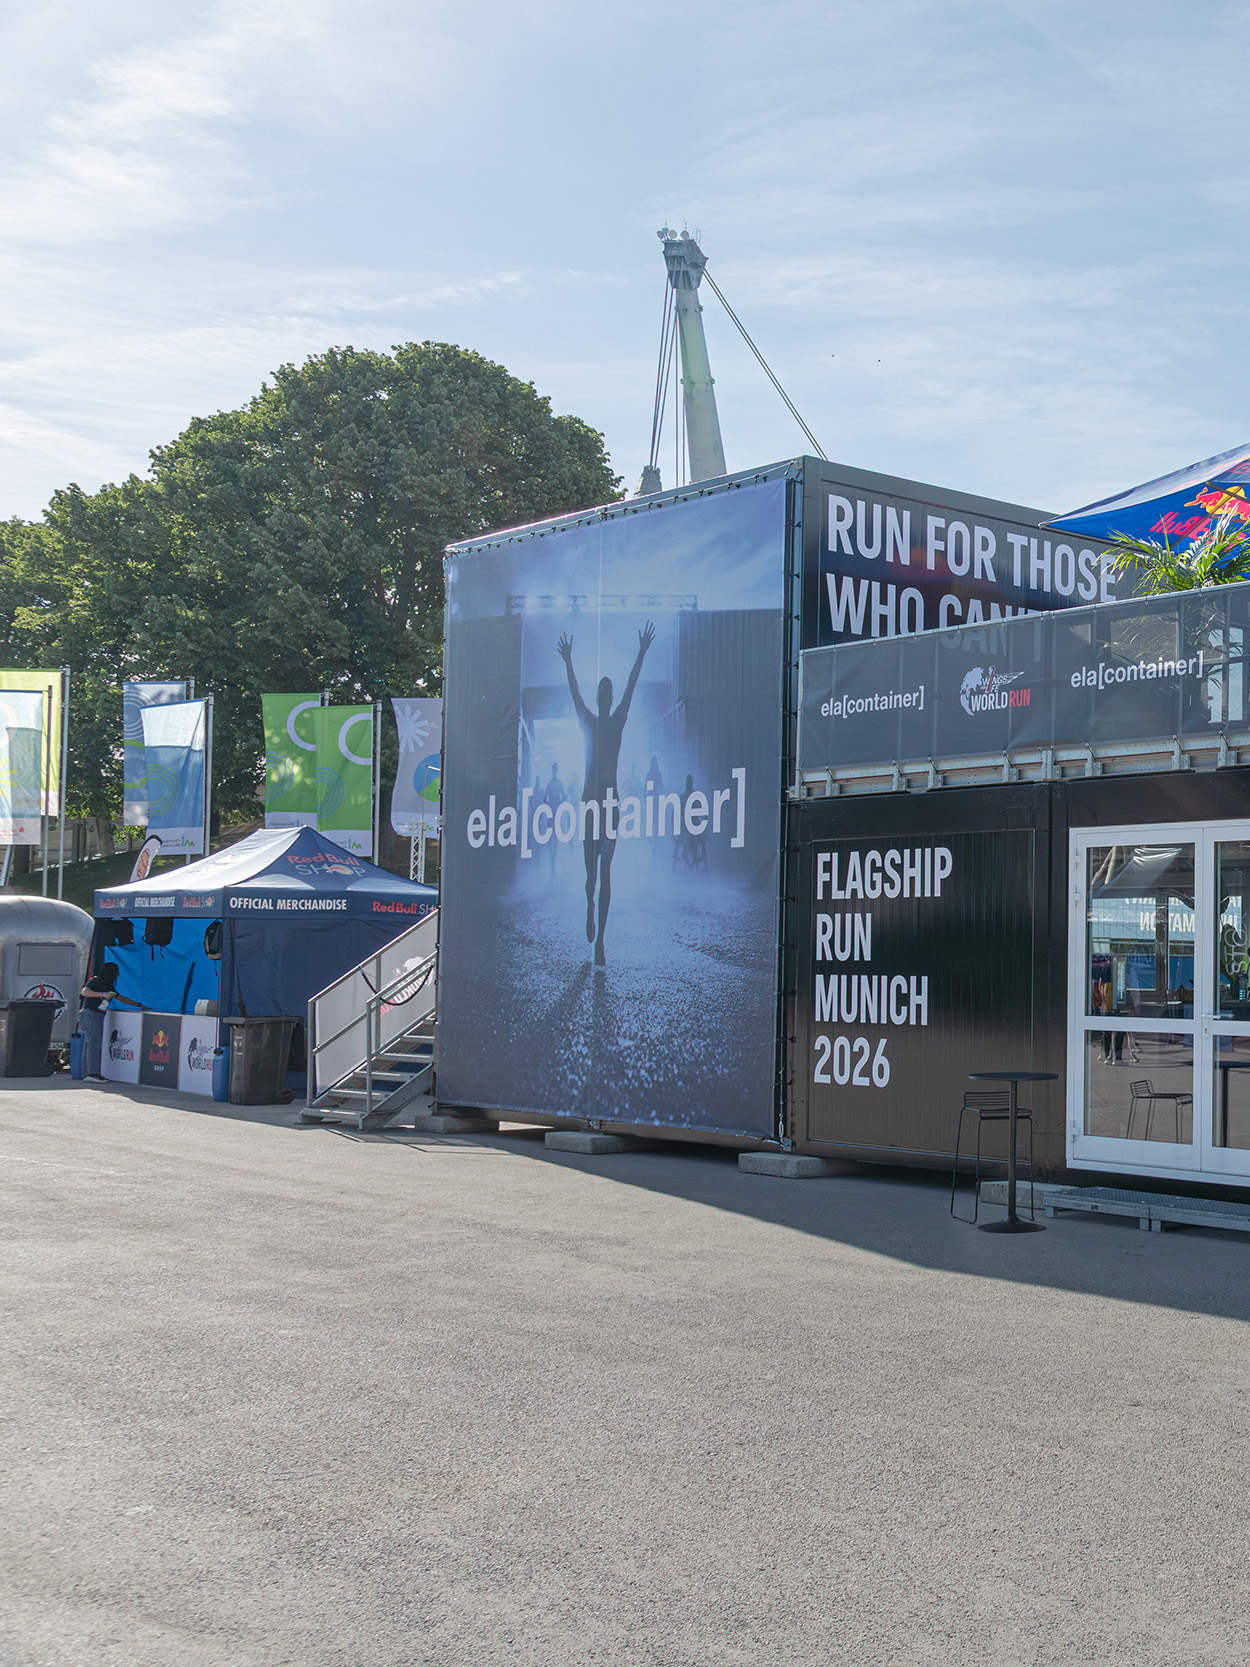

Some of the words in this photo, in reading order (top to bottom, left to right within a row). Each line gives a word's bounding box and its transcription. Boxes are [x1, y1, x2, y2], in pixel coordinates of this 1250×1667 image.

[828, 493, 911, 566] RUN
[926, 515, 997, 583] FOR
[1006, 532, 1117, 602] THOSE
[826, 572, 925, 639] WHO
[1070, 650, 1204, 690] ela[container]
[821, 685, 924, 718] ela[container]
[970, 691, 1009, 712] WORLD
[1009, 688, 1031, 708] RUN
[467, 767, 746, 859] ela[container]
[286, 852, 326, 864] Red
[325, 853, 360, 866] Bull
[817, 847, 953, 900] FLAGSHIP
[229, 897, 274, 910] OFFICIAL
[276, 897, 347, 911] MERCHANDISE
[373, 901, 395, 912] Red
[396, 902, 418, 914] Bull
[816, 913, 872, 962] RUN
[814, 974, 929, 1026] MUNICH
[813, 1034, 891, 1088] 2026
